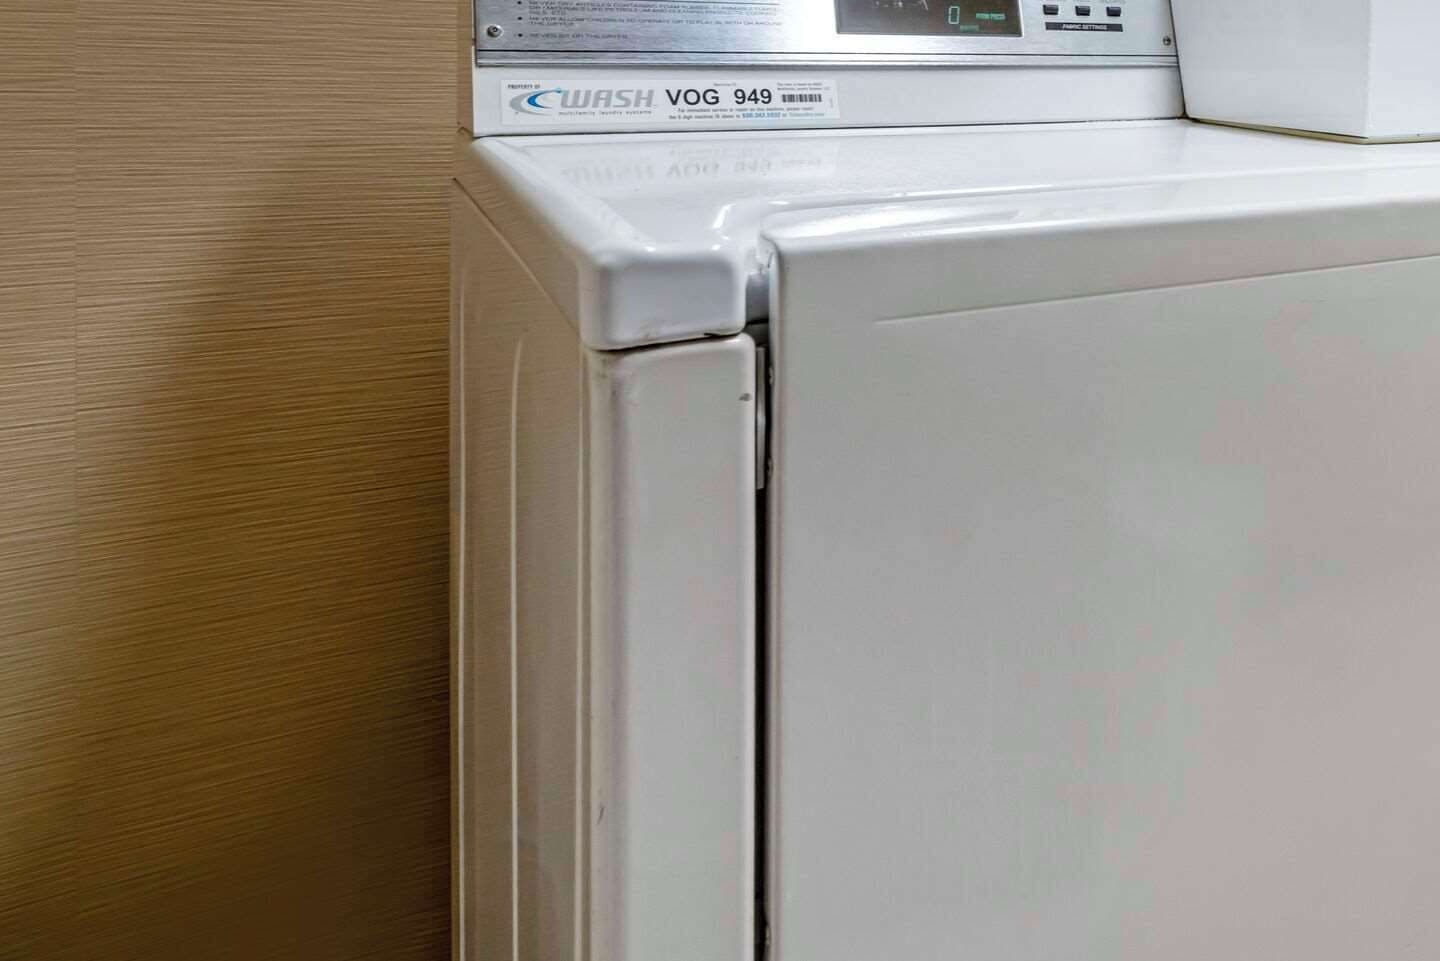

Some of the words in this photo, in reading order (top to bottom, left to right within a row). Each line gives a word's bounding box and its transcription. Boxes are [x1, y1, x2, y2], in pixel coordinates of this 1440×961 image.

[560, 88, 655, 109] WASH
[665, 88, 720, 106] VOG
[733, 88, 773, 105] 949
